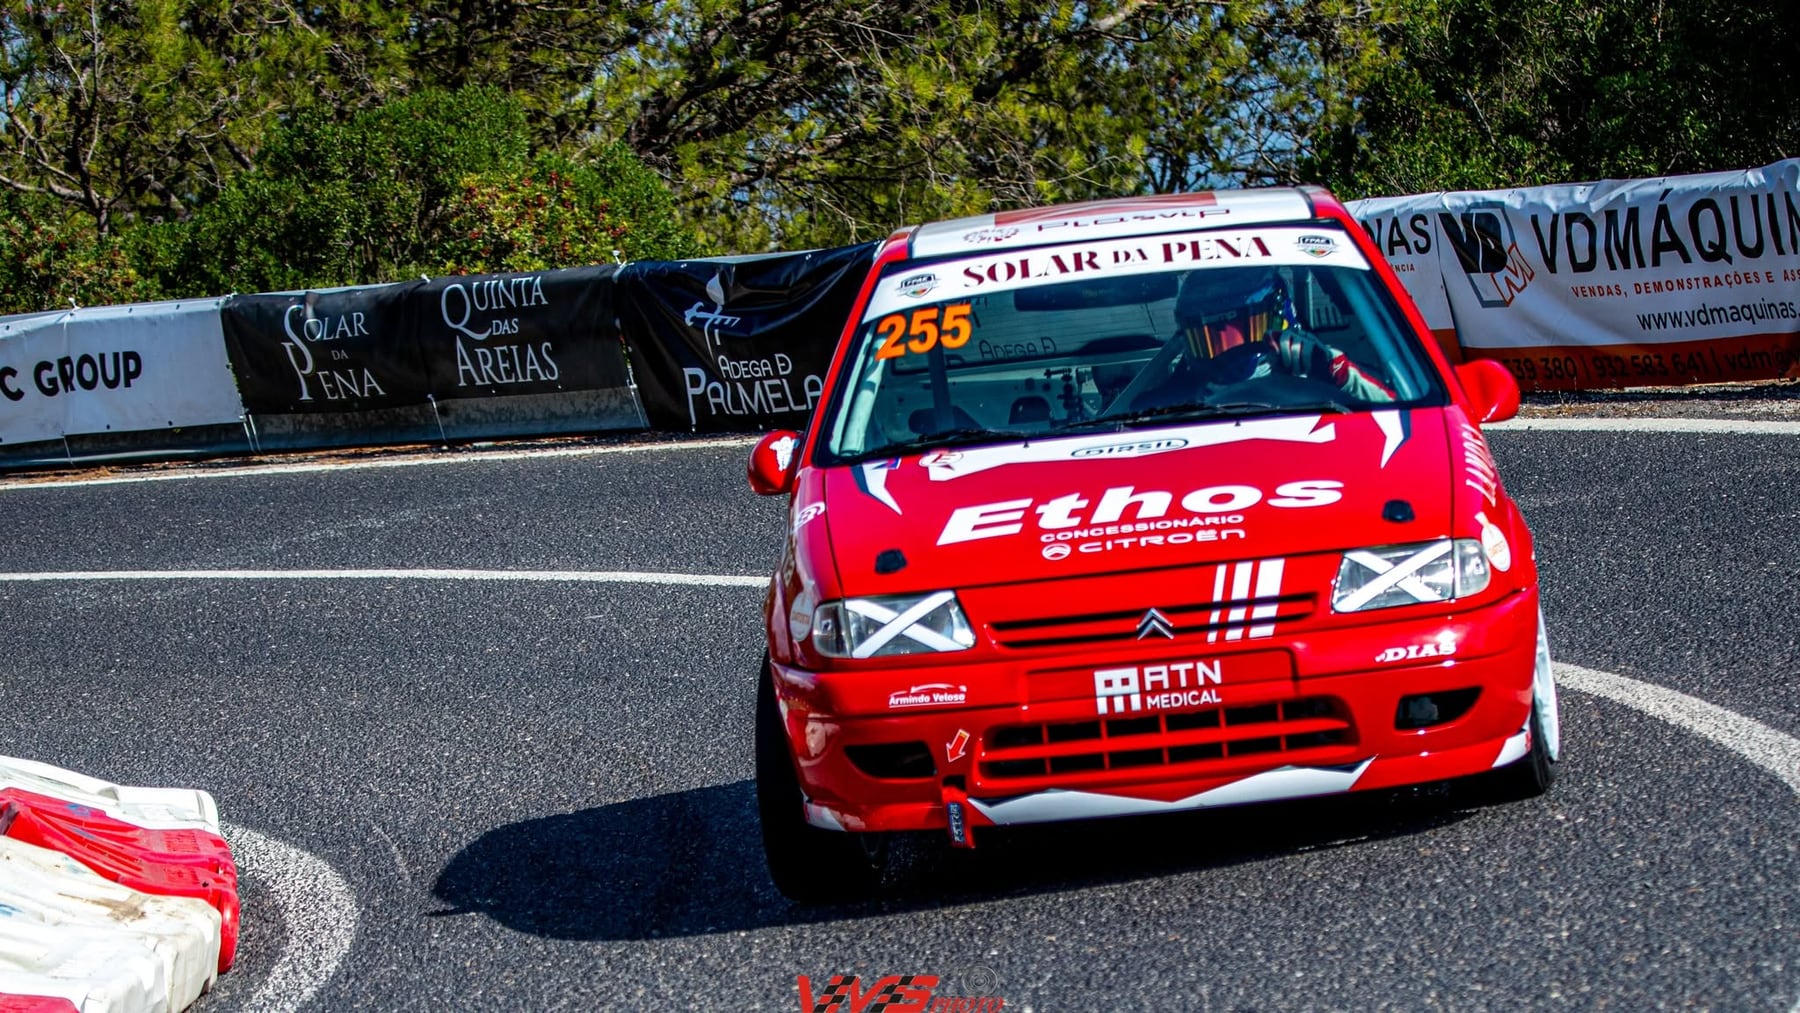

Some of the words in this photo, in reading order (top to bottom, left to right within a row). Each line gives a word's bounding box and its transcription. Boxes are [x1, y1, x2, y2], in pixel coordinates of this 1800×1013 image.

[963, 251, 1102, 288] SOLAR
[1113, 249, 1149, 263] DA
[1163, 237, 1272, 262] PENA
[1572, 283, 1629, 299] VENDAS,
[1634, 270, 1761, 295] DEMONSTRAÇÕES
[1765, 271, 1776, 284] E
[441, 276, 549, 341] QUINTA
[492, 318, 519, 336] DAS
[876, 303, 972, 361] 255
[284, 305, 370, 374] SOLAR
[331, 350, 350, 361] DA
[456, 335, 559, 387] AREIAS
[34, 351, 142, 397] GROUP
[281, 342, 387, 401] PENA
[718, 355, 774, 379] ADEGA
[683, 374, 824, 425] PALMELA
[935, 479, 1345, 546] Ethos
[889, 693, 931, 706] Armindo
[932, 691, 966, 703] Veloso
[1143, 659, 1222, 691] ATN
[1146, 689, 1222, 710] MEDICAL
